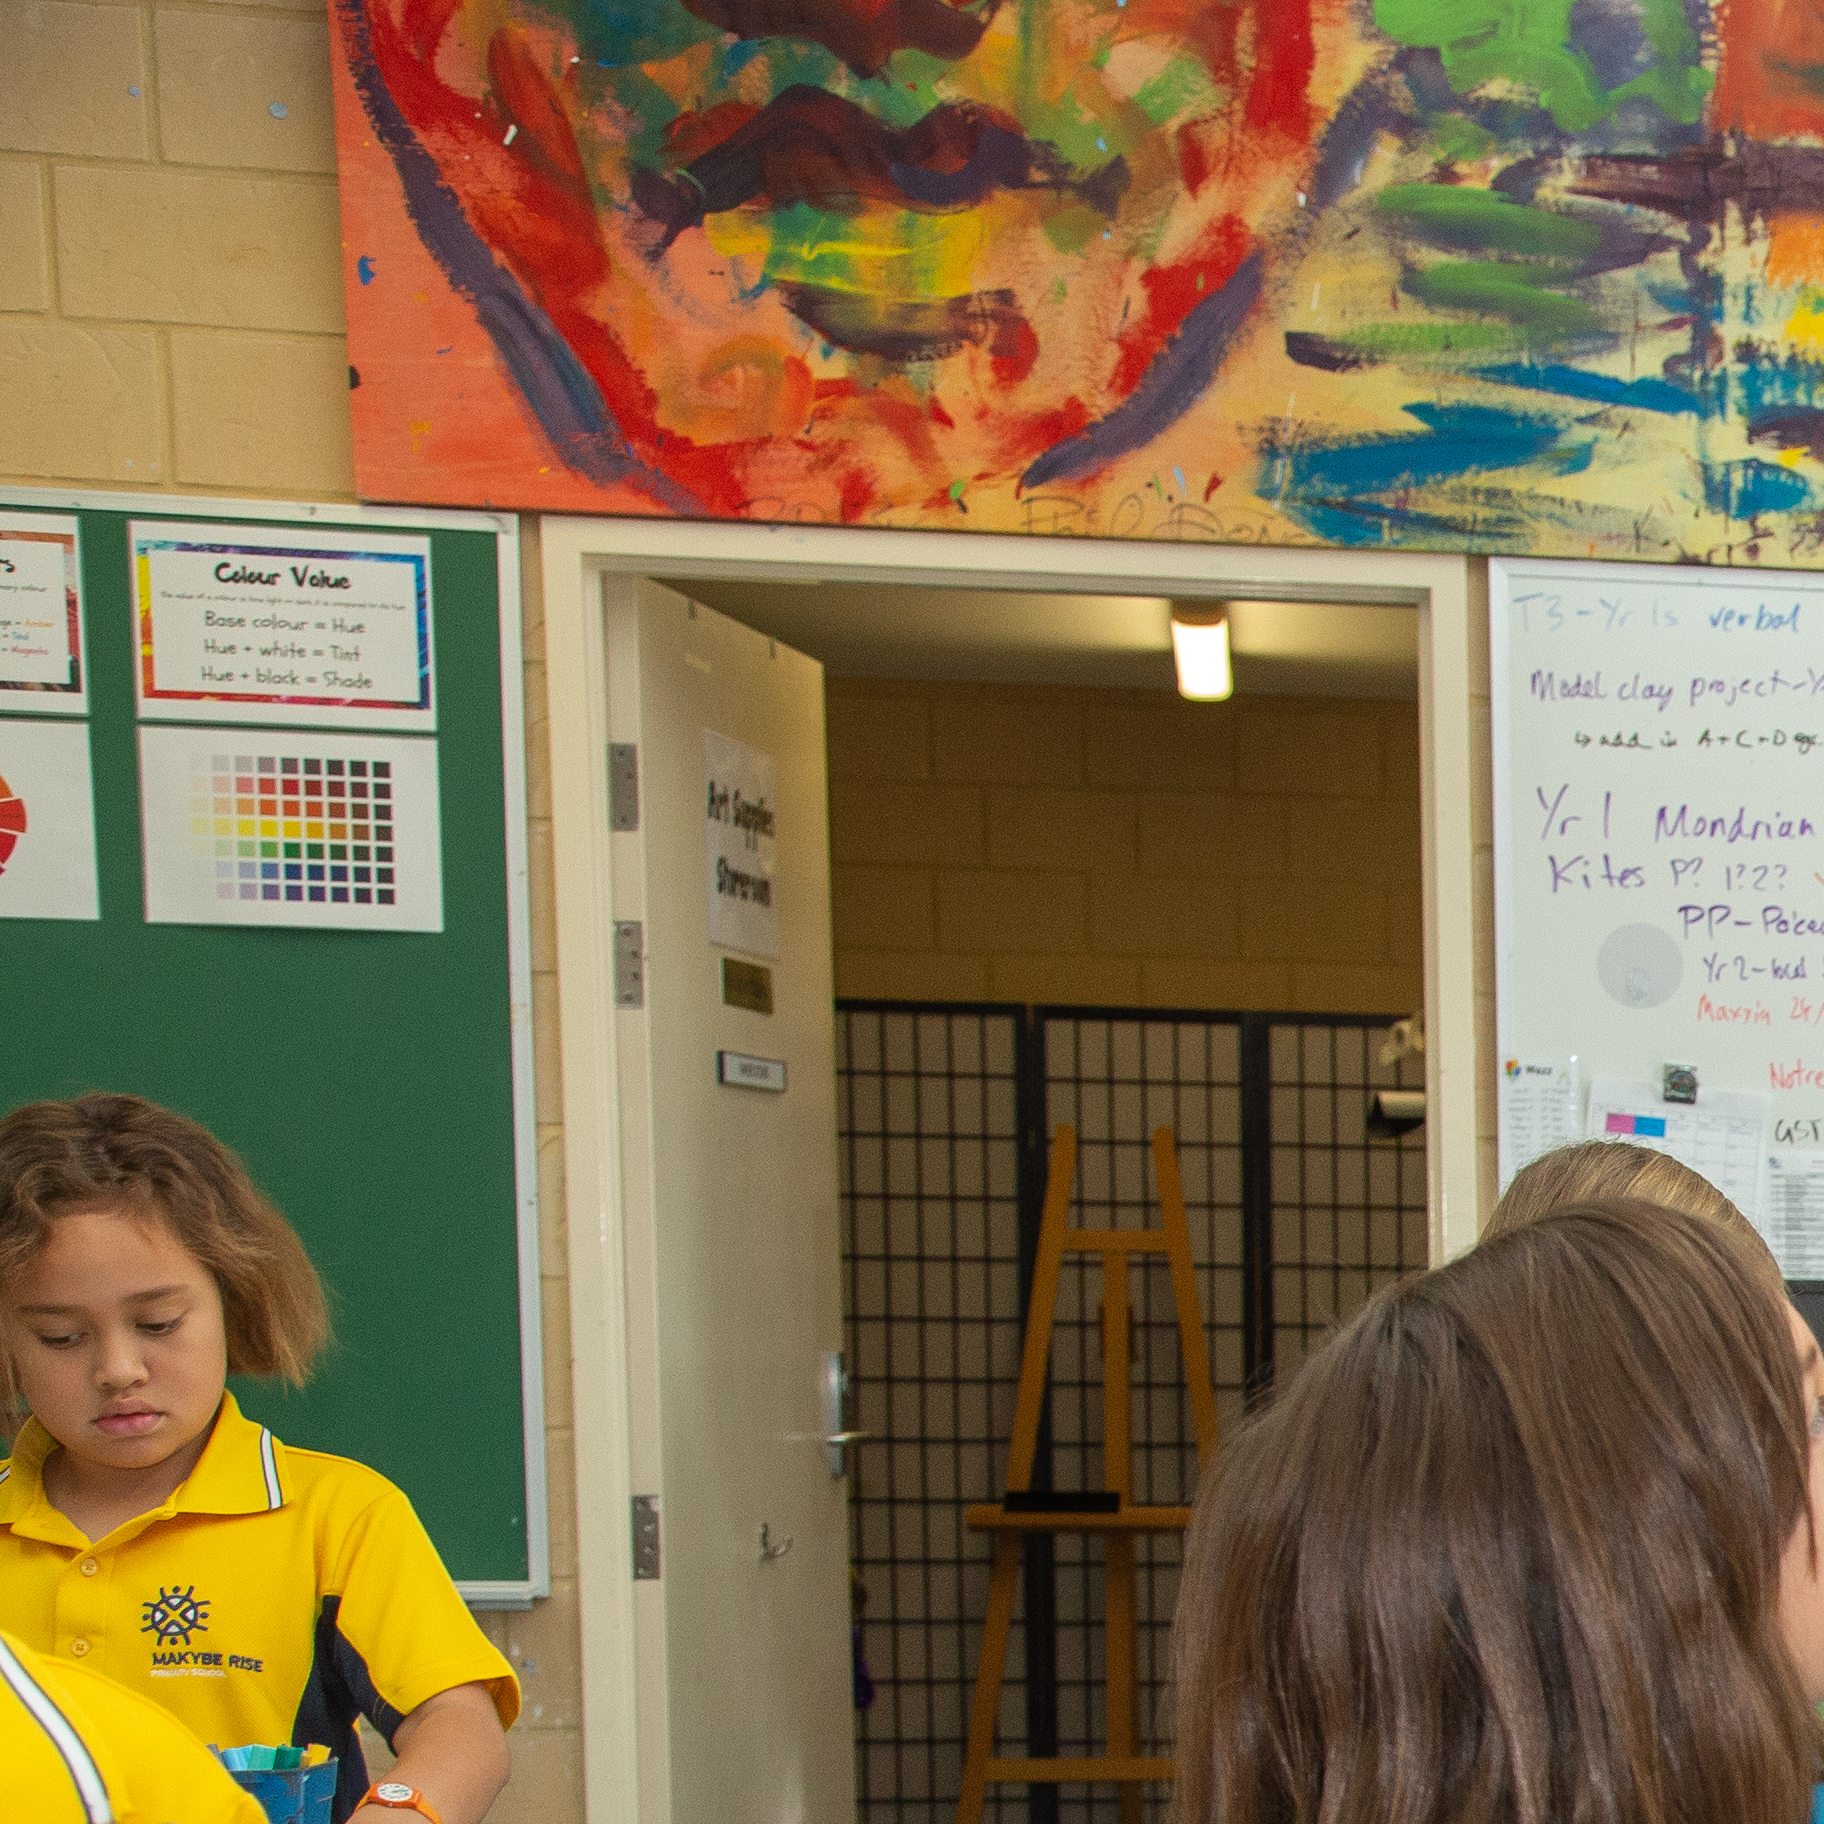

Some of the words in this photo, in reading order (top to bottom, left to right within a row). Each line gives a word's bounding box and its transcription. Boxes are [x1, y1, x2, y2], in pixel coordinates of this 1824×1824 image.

[214, 561, 281, 587] Colour
[291, 564, 352, 590] Value
[204, 610, 248, 628] Base
[251, 613, 309, 632] colour
[331, 617, 366, 635] Hue
[1709, 603, 1801, 635] verbal
[204, 638, 238, 656] Hue
[259, 641, 308, 659] white
[330, 644, 362, 662] Tint
[201, 666, 236, 684] Hue
[255, 667, 301, 687] black
[322, 671, 374, 690] Shade
[1617, 674, 1673, 713] clay
[1536, 783, 1582, 841] Yr
[1654, 802, 1817, 844] Mondrian
[1549, 853, 1646, 895] Kites
[151, 1650, 224, 1666] MAKYBE
[227, 1653, 264, 1673] RISE
